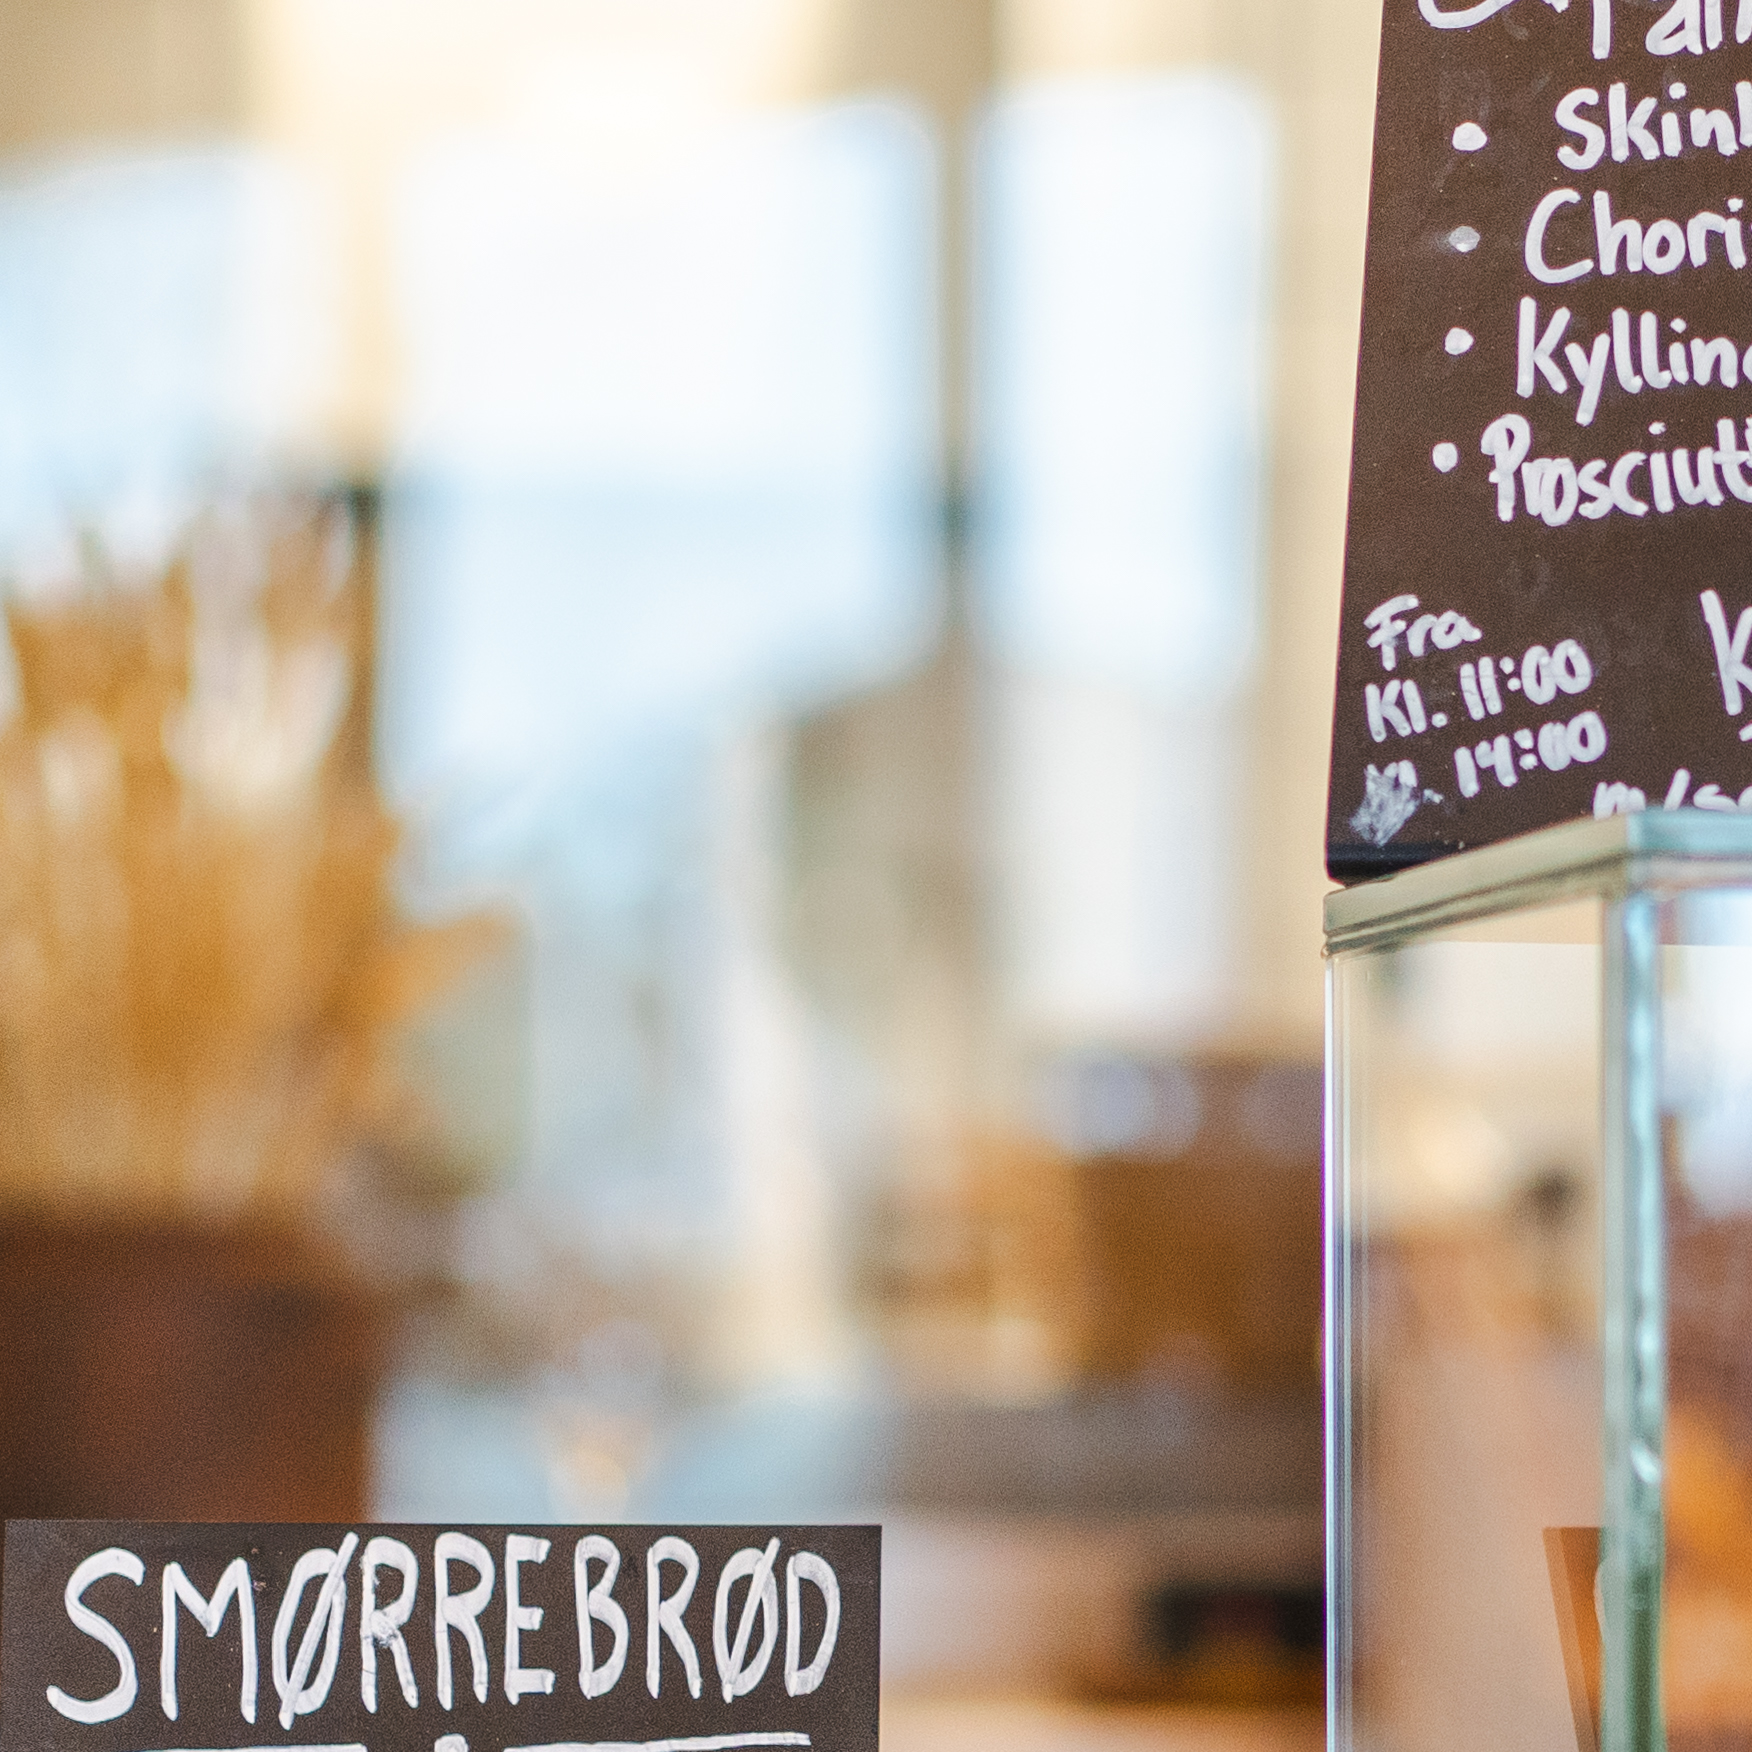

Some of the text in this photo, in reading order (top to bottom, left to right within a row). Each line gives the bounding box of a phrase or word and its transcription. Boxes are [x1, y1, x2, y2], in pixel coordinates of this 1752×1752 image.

[1363, 593, 1490, 677] Fra
[1452, 632, 1599, 727] 11:00
[1453, 703, 1608, 798] 14:00
[45, 1531, 842, 1731] SMØRREBRØD
